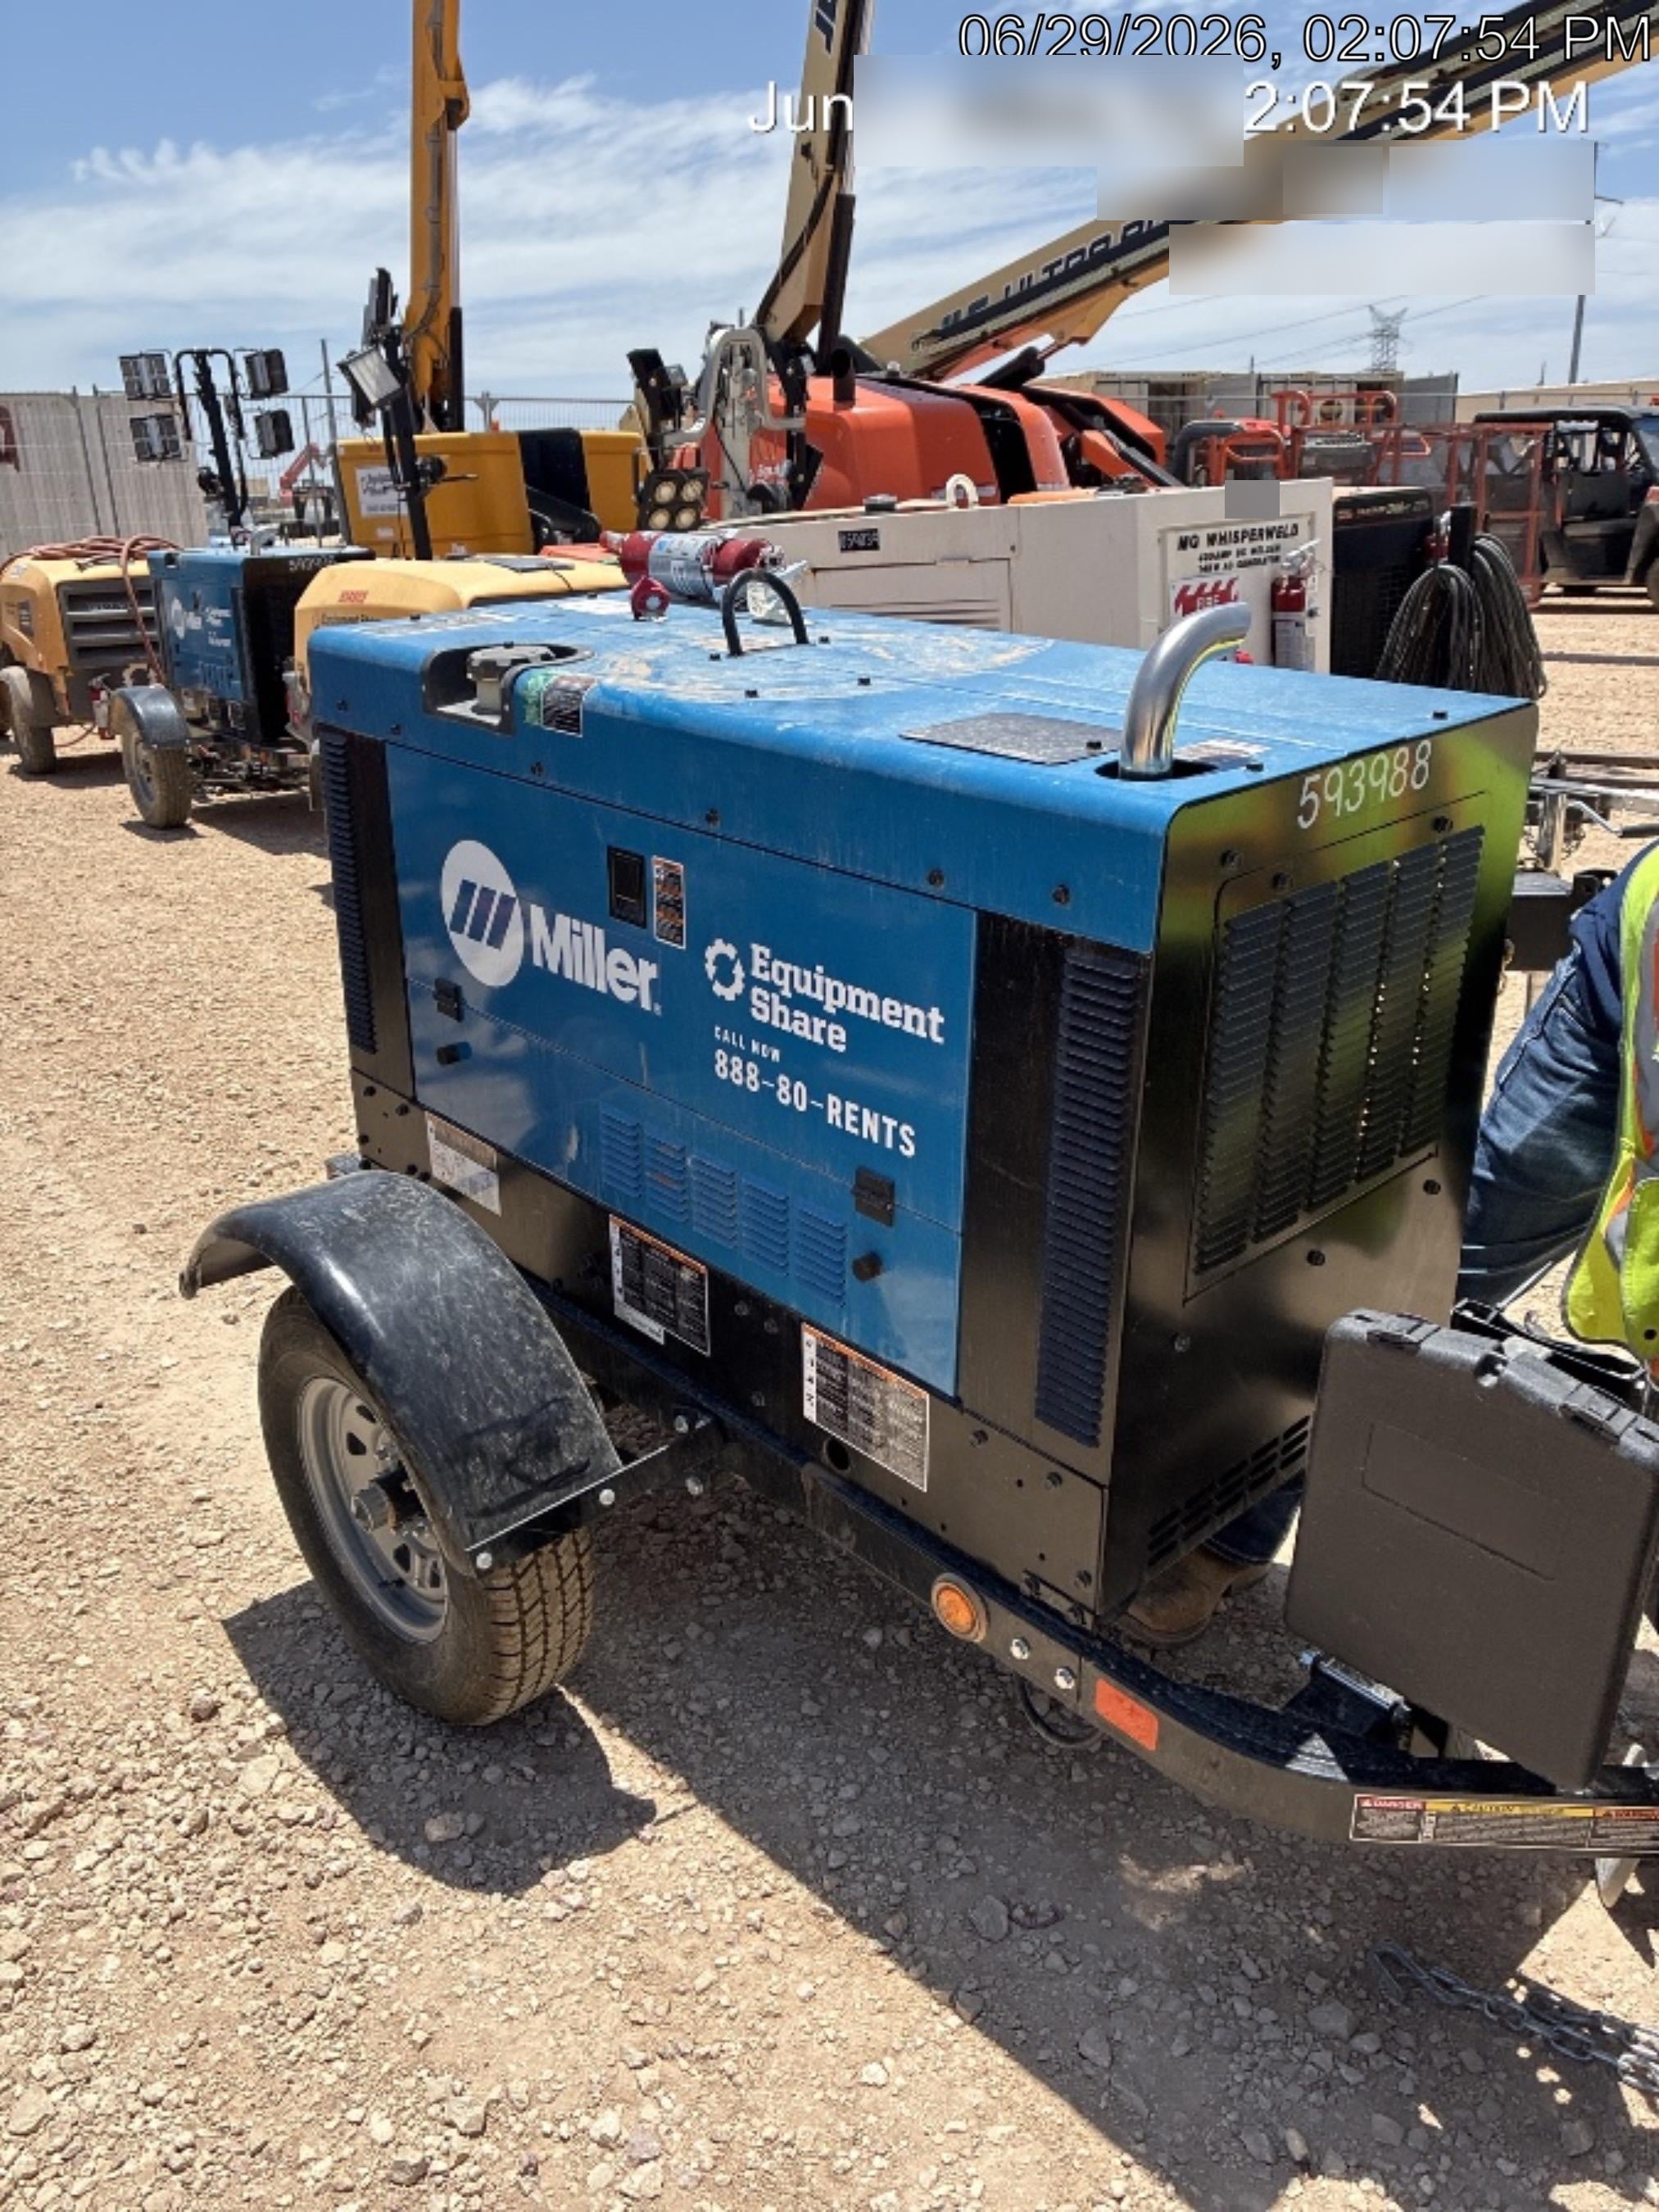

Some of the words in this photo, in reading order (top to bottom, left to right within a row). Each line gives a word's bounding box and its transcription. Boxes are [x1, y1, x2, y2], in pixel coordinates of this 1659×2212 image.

[1207, 524, 1299, 547] WHISPERWELD
[1297, 740, 1431, 829] 593988
[750, 943, 945, 1045] Equipment
[750, 986, 847, 1052] Share
[714, 1026, 746, 1050] CALL
[751, 1039, 781, 1063] NOW
[714, 1049, 916, 1158] 888-80-RENTS
